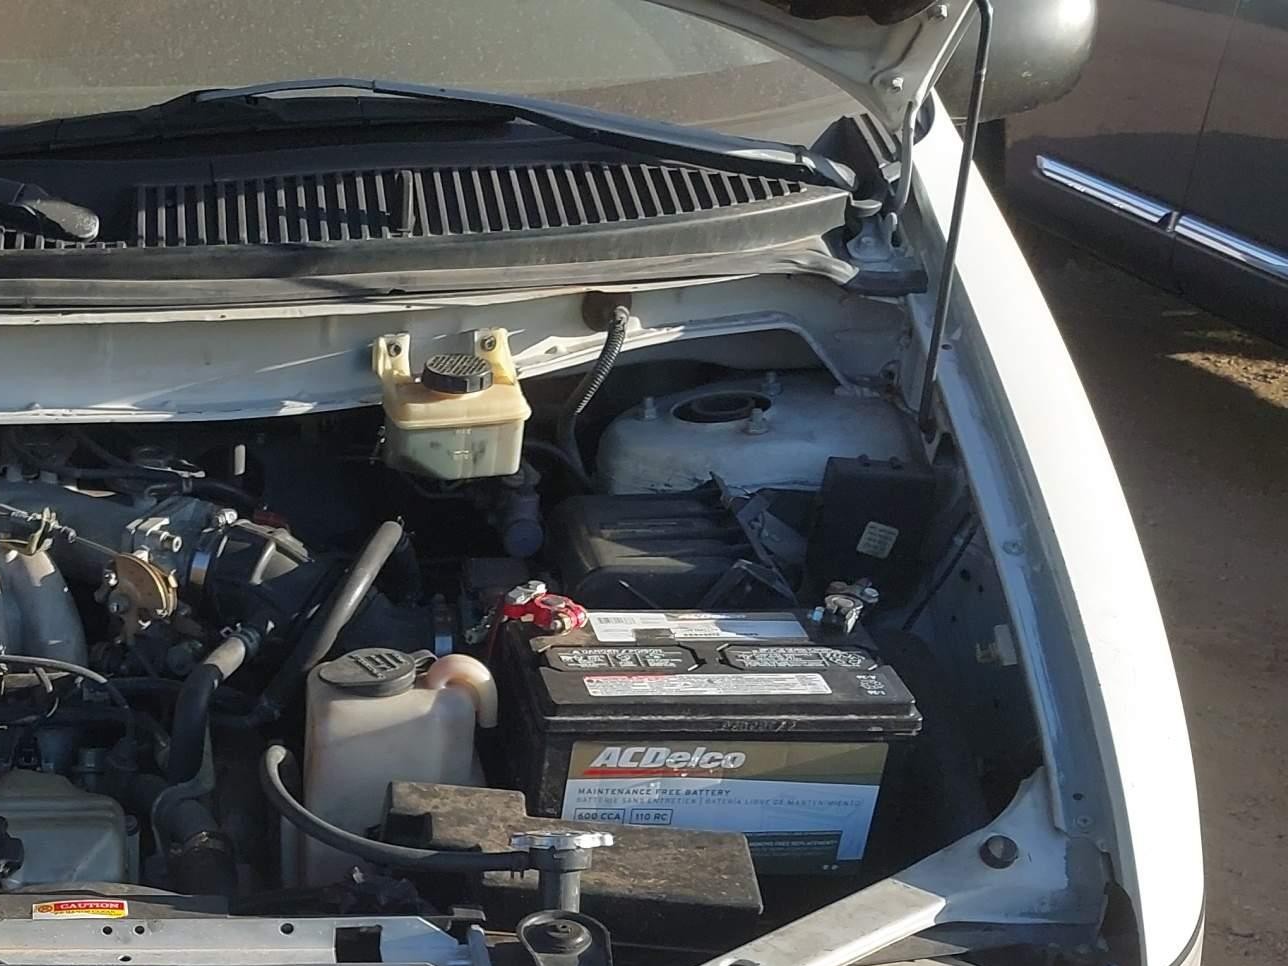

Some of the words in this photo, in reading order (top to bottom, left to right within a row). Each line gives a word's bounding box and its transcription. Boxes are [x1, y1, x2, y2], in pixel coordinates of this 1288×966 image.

[590, 746, 747, 770] ACDelco
[578, 787, 652, 796] MAINTENANCE
[655, 788, 681, 796] FREE
[684, 789, 731, 797] BATTERY
[577, 812, 597, 821] 600
[600, 812, 621, 821] CCA
[635, 813, 650, 821] 110
[654, 813, 668, 822] RC
